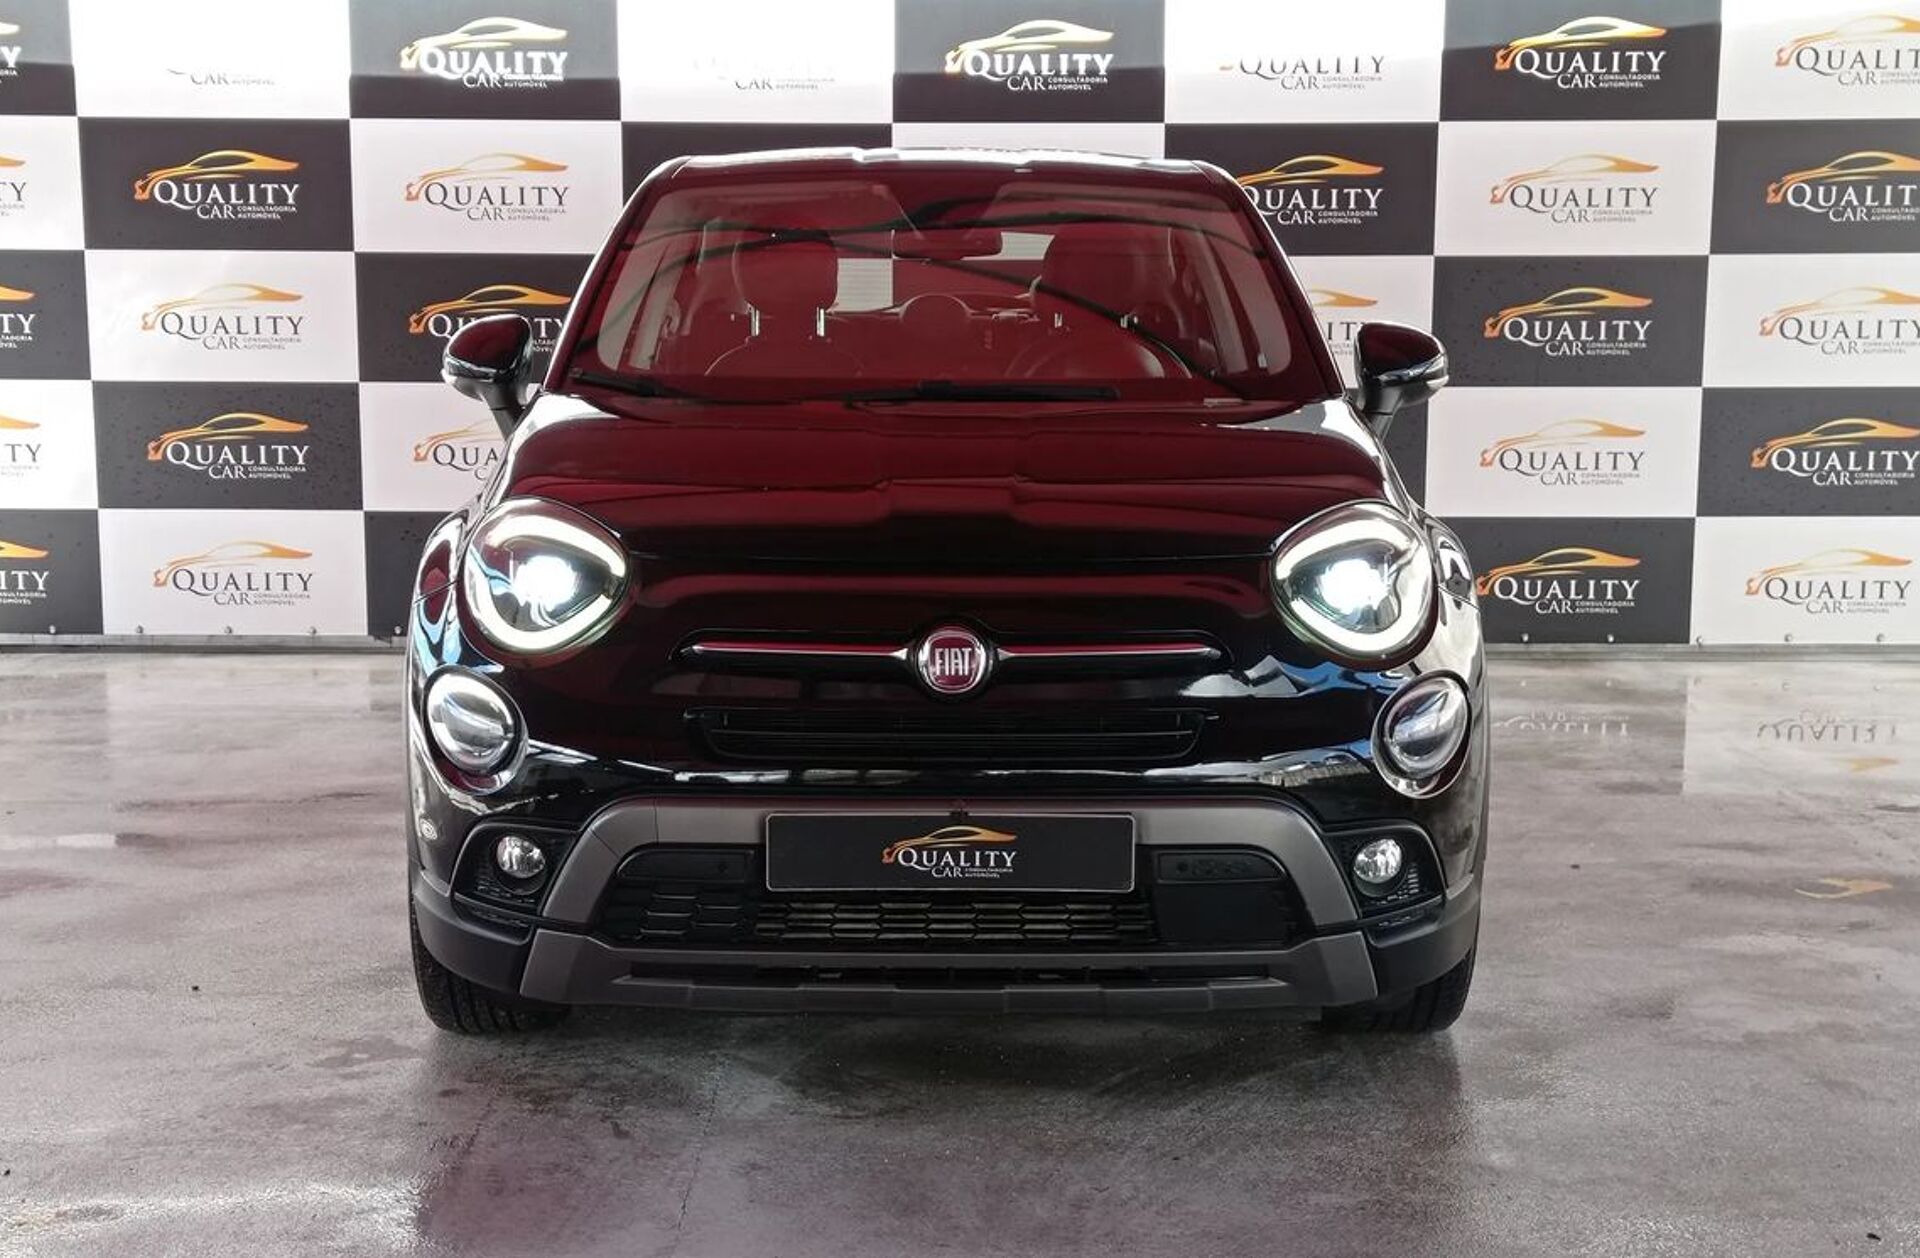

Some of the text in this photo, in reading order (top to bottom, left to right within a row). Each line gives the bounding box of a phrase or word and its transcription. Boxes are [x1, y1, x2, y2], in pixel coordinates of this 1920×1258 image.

[419, 47, 568, 79] QUALITY
[963, 50, 1114, 81] QUALITY
[1515, 48, 1667, 80] QUALITY
[1795, 47, 1920, 76] QUALIT
[462, 72, 501, 89] CAR
[1007, 75, 1046, 91] CAR
[1281, 75, 1320, 91] CAR
[1557, 73, 1597, 89] CAR
[1837, 71, 1879, 86] CAR
[154, 180, 299, 209] QUALITY
[425, 182, 569, 211] QUALITY
[1510, 184, 1658, 213] QUALITY
[1787, 182, 1920, 213] QUALIT
[196, 204, 235, 219] CAR
[467, 206, 504, 221] CAR
[1277, 210, 1316, 225] CAR
[1550, 208, 1589, 224] CAR
[1828, 206, 1870, 222] CAR
[162, 312, 303, 340] QUALITY
[1503, 317, 1652, 346] QUALITY
[202, 336, 239, 351] CAR
[1545, 341, 1584, 356] CAR
[1821, 341, 1859, 355] CAR
[166, 441, 310, 470] QUALITY
[1500, 448, 1645, 477] QUALITY
[1771, 448, 1919, 477] QUALITY
[208, 464, 247, 479] CAR
[1540, 472, 1577, 487] CAR
[1813, 471, 1852, 486] CAR
[173, 568, 313, 597] QUALITY
[213, 592, 251, 606] CAR
[1494, 577, 1640, 606] QUALITY
[1765, 577, 1911, 605] QUALITY
[1534, 599, 1574, 614] CAR
[1806, 600, 1844, 614] CAR
[935, 648, 972, 676] FIAT
[898, 847, 1017, 870] QUALITY
[931, 865, 962, 878] CAR
